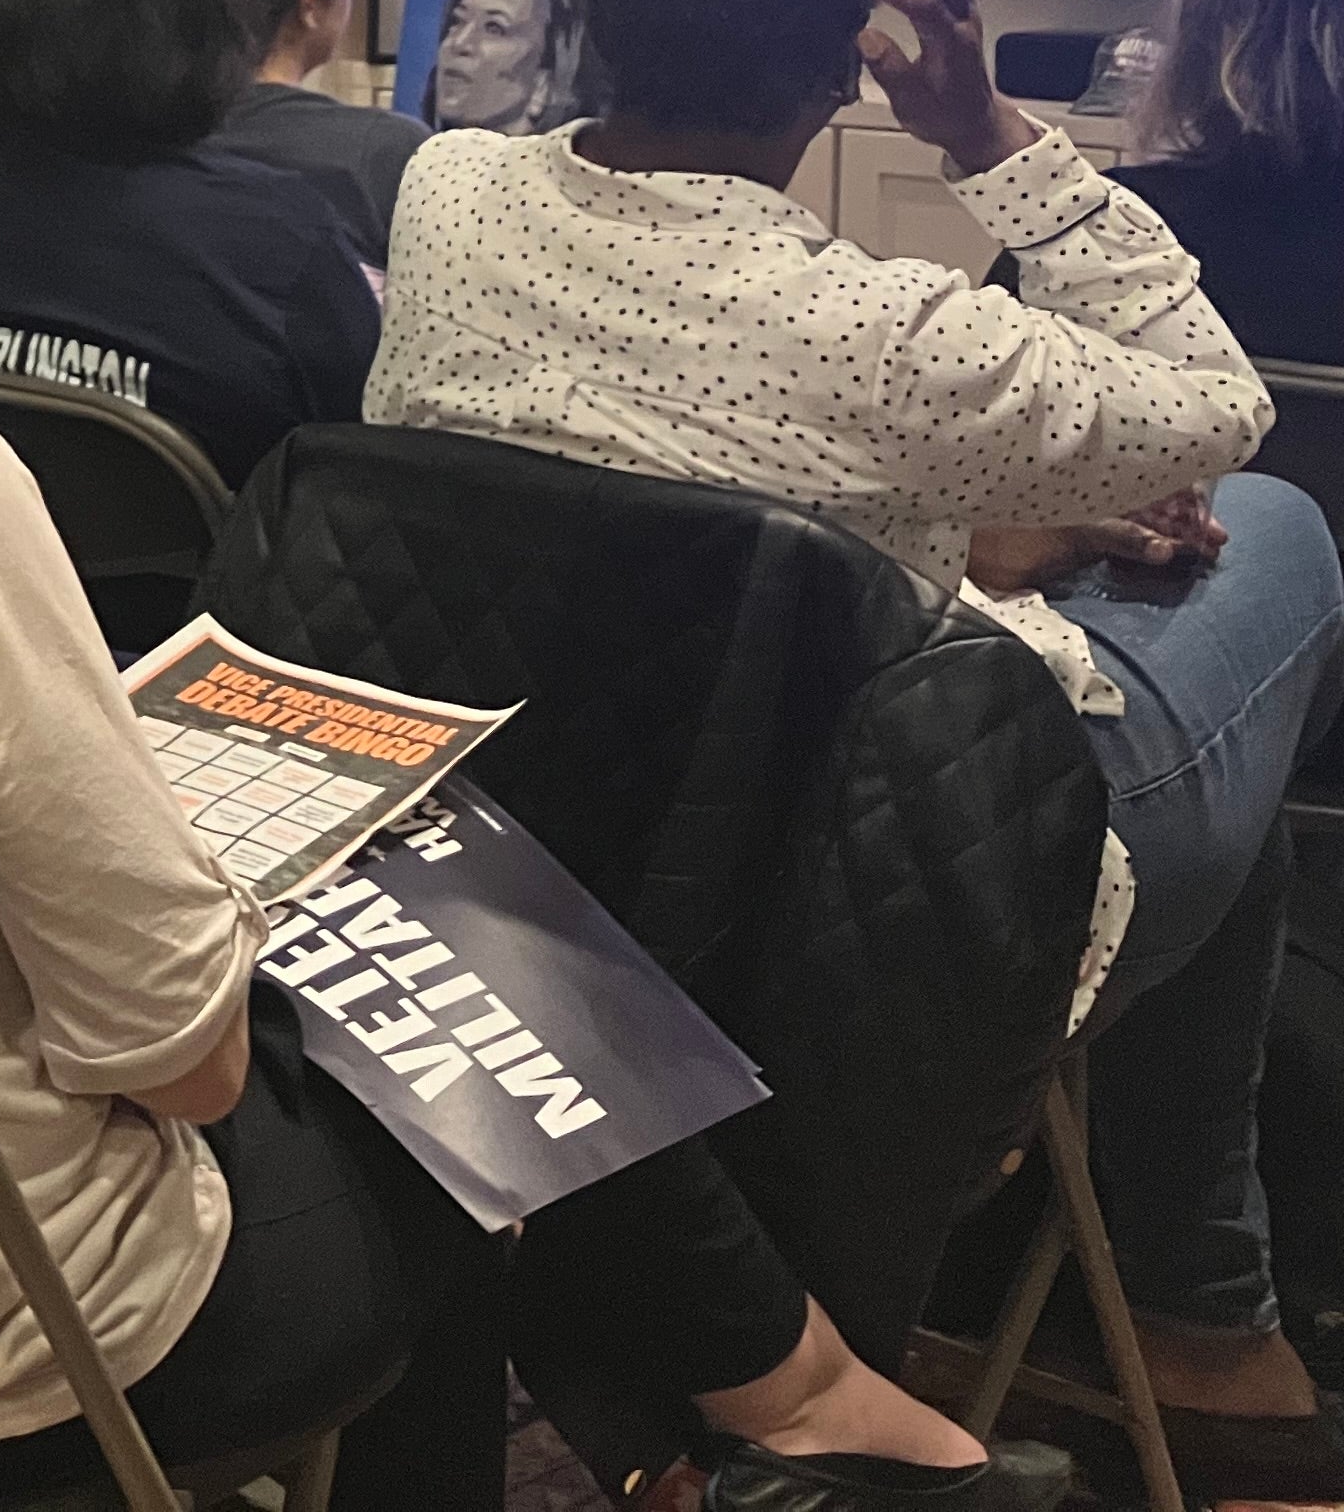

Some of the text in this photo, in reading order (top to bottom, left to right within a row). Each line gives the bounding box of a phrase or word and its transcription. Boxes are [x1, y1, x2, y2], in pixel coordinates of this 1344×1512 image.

[175, 679, 319, 734] DEBATE
[303, 719, 437, 767] BINGO
[205, 662, 275, 696] VICE
[265, 685, 459, 746] PRESIDENTIAL
